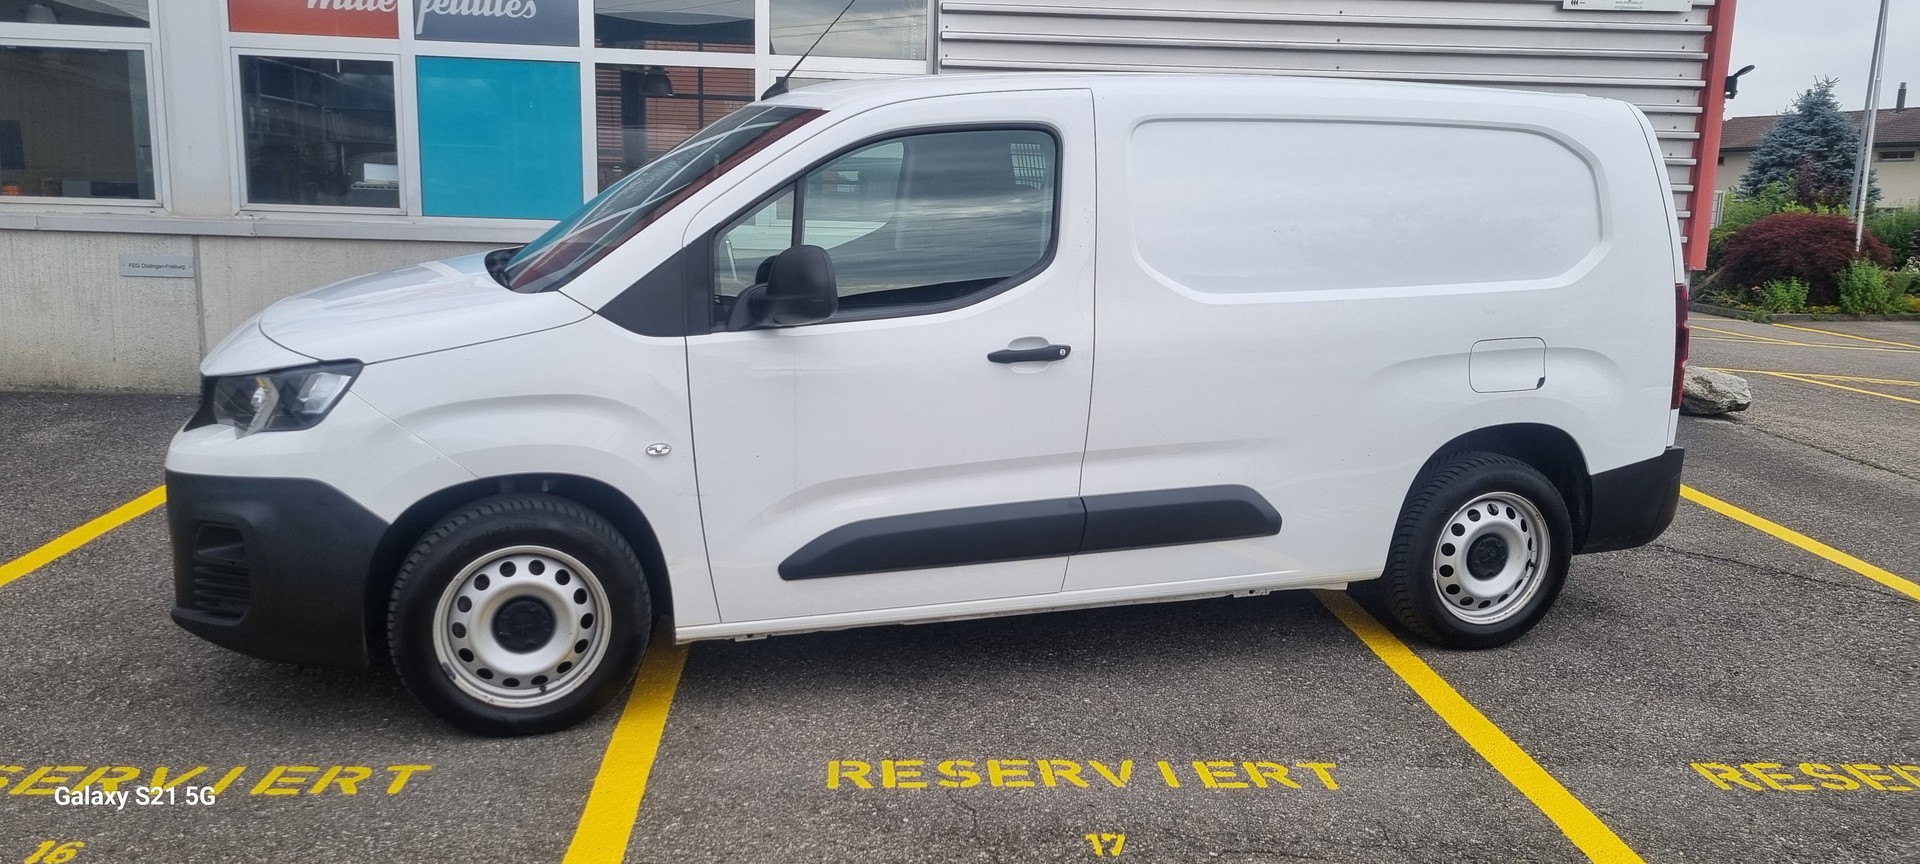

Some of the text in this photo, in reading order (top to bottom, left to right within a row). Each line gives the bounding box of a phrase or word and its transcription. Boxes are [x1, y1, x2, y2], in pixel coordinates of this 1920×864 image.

[0, 764, 432, 797] ERVIERT
[827, 758, 1340, 790] RESERVIERT
[24, 840, 85, 864] 16
[1086, 832, 1127, 857] 17
